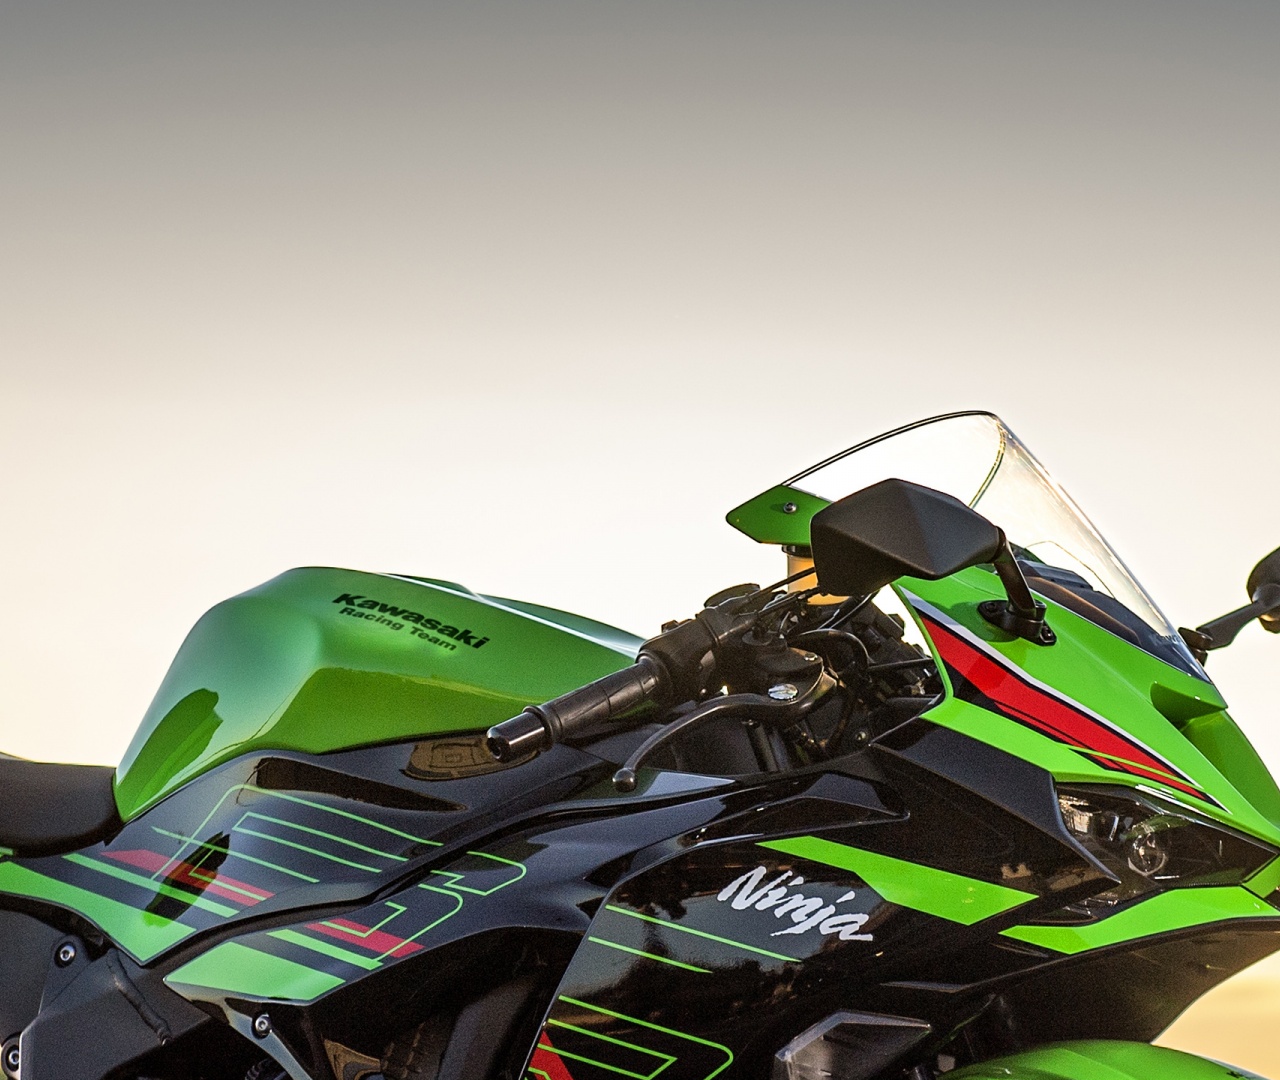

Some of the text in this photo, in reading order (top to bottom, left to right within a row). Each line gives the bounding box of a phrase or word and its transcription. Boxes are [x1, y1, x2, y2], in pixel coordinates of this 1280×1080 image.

[332, 593, 490, 649] Kawasaki
[339, 606, 458, 651] Racing Team
[717, 865, 874, 941] Ninja
